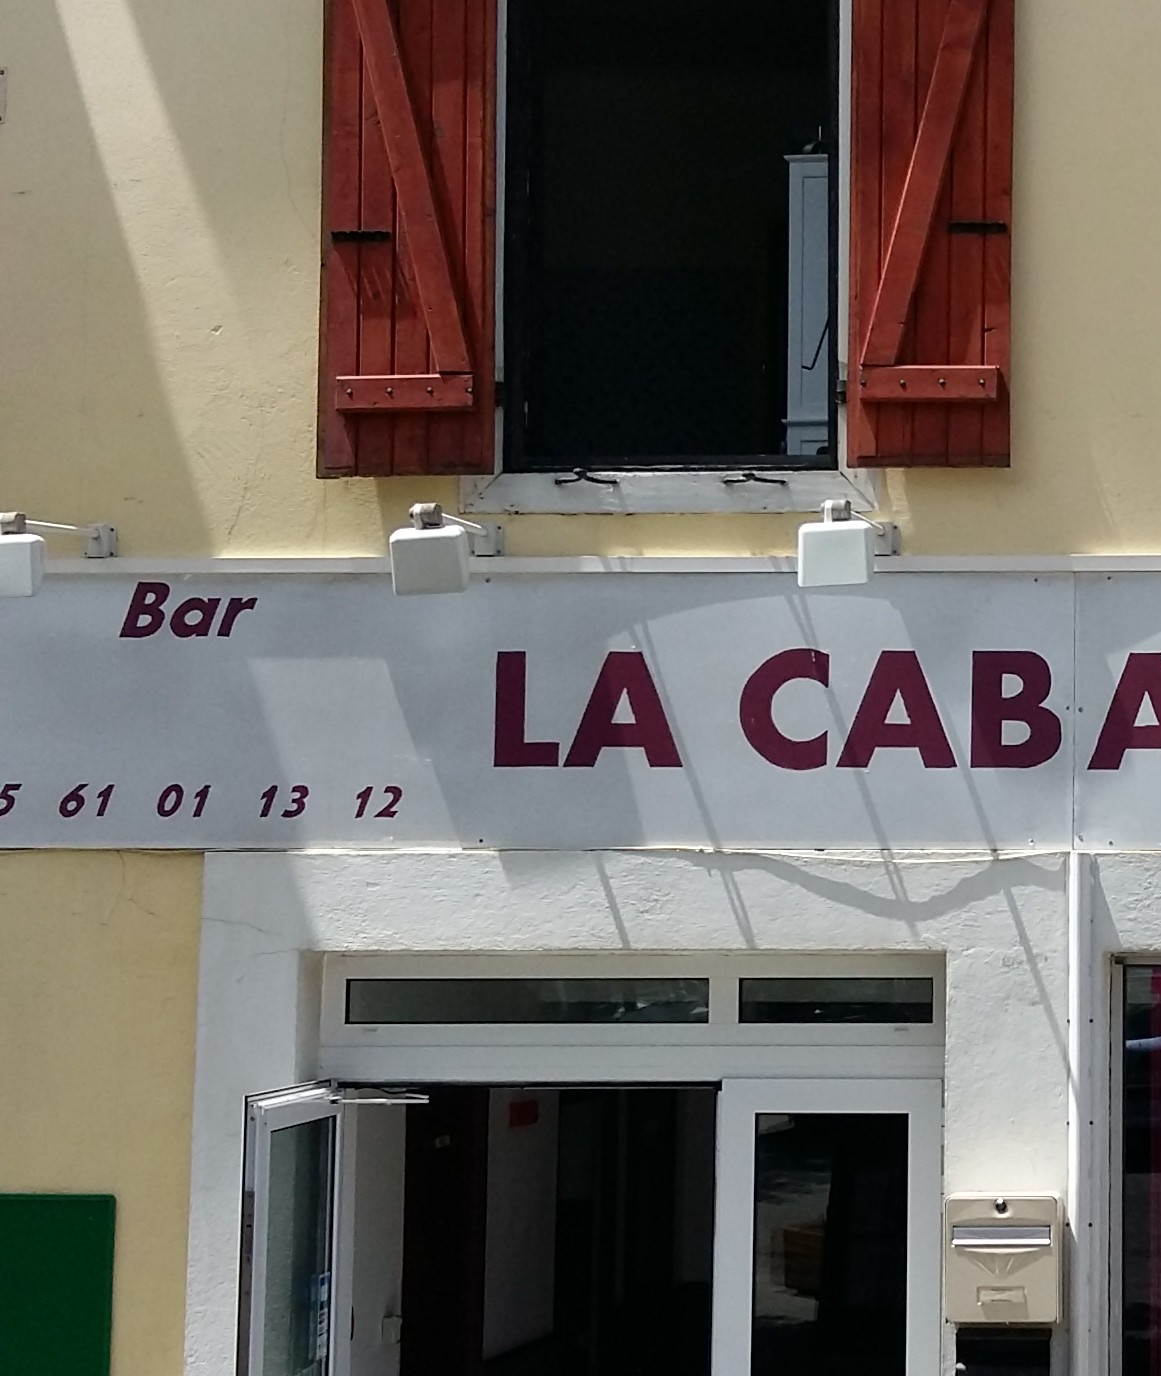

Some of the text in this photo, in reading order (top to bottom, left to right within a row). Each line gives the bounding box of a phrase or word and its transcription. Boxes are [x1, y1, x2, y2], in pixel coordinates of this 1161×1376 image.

[119, 581, 258, 638] Bar
[493, 650, 684, 768] LA
[58, 783, 116, 818] 61
[156, 783, 212, 818] 01
[259, 784, 310, 819] 13
[354, 785, 403, 819] 12
